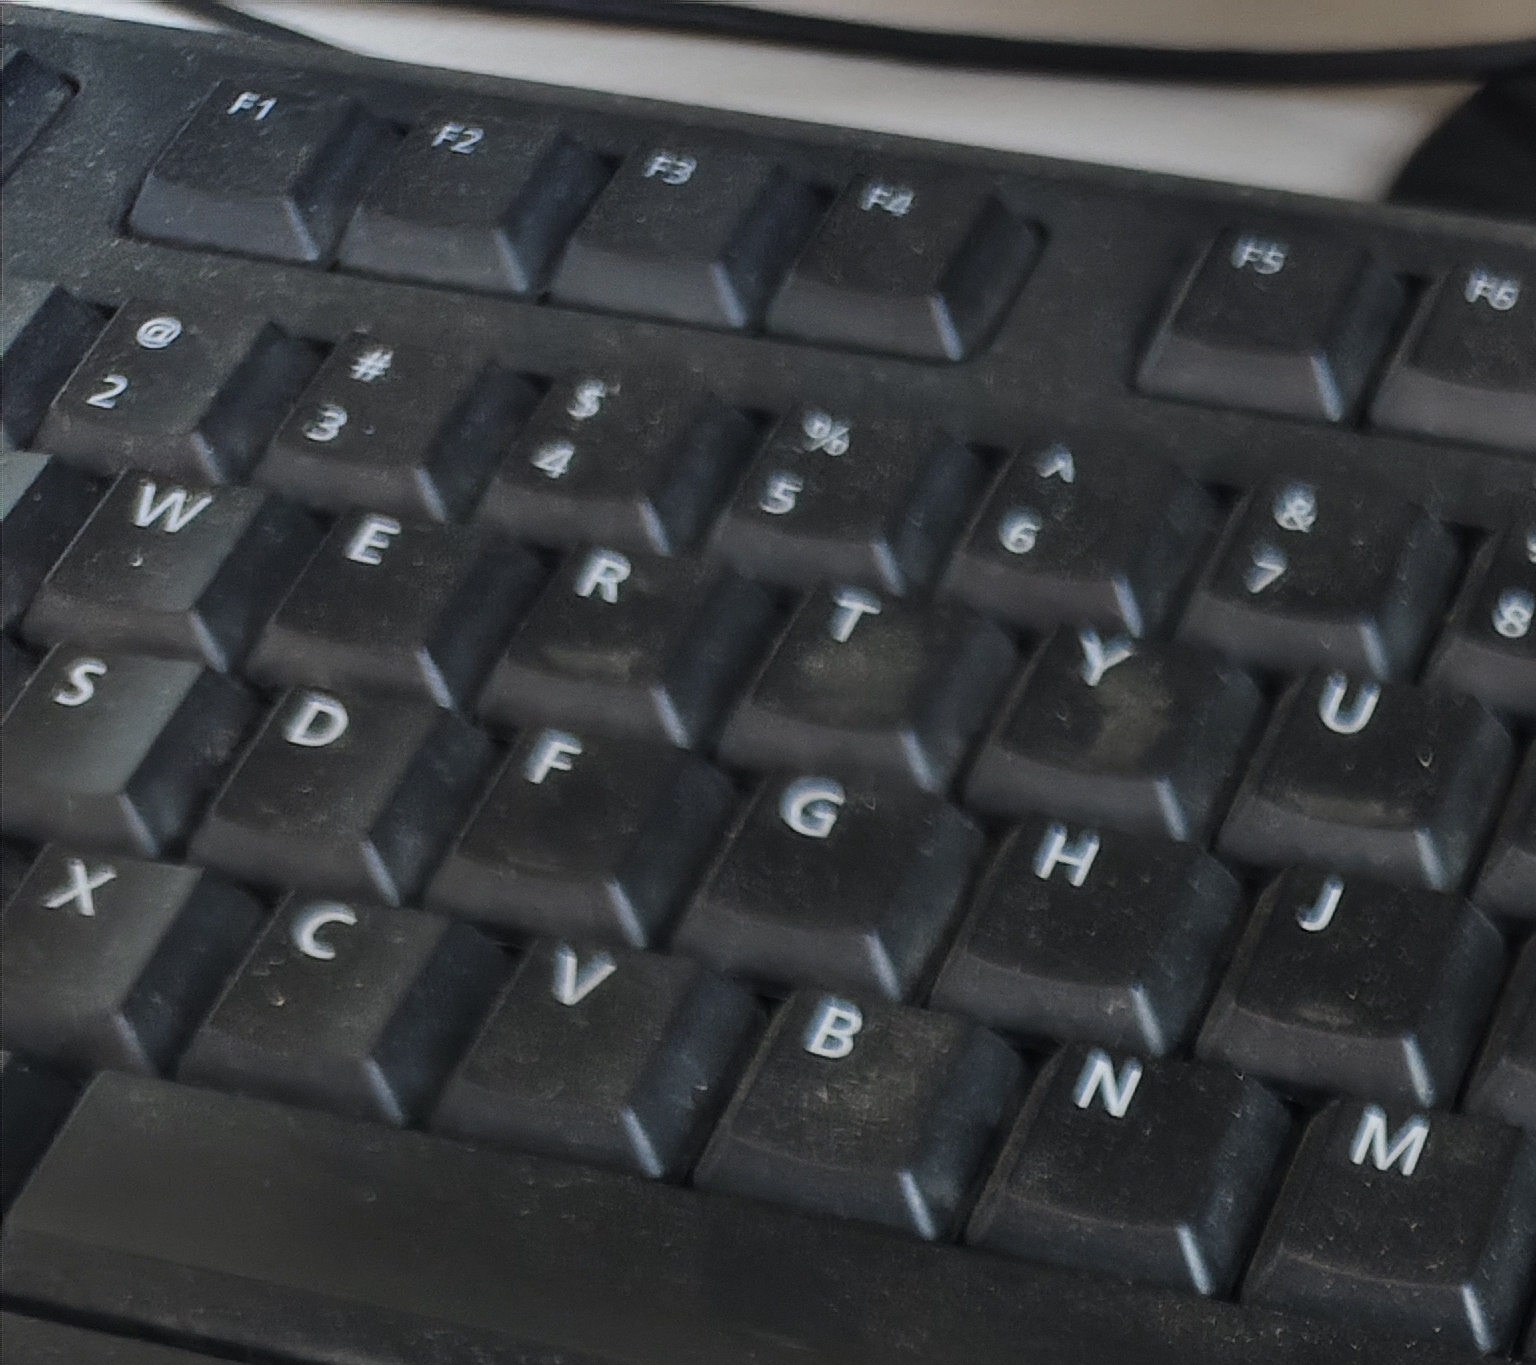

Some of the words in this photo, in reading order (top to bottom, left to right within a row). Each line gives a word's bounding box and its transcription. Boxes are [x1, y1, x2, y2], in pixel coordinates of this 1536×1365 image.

[227, 91, 277, 121] F1
[431, 121, 484, 154] F2
[644, 151, 697, 185] F3
[860, 185, 915, 217] F4
[1232, 240, 1286, 275] F5
[1465, 273, 1520, 311] F6
[136, 316, 182, 349] @
[351, 349, 393, 382] #
[86, 374, 128, 409] 2
[568, 383, 606, 421] $
[306, 404, 348, 442] 3
[804, 414, 850, 457] %
[533, 443, 575, 479] 4
[134, 482, 213, 533] W
[759, 475, 803, 515] 5
[1274, 489, 1316, 533] &
[346, 515, 401, 565] E
[1000, 515, 1041, 554] 6
[577, 549, 632, 604] R
[1248, 551, 1287, 594] 7
[833, 591, 881, 643] T
[1494, 596, 1534, 639] 8
[1081, 630, 1133, 687] Y
[54, 658, 107, 706] S
[1320, 673, 1382, 734] U
[286, 694, 349, 747] D
[527, 732, 583, 784] F
[781, 778, 846, 838] G
[1035, 828, 1100, 887] H
[45, 859, 117, 916] X
[1299, 883, 1343, 932] J
[294, 904, 358, 960] C
[554, 949, 617, 1006] V
[805, 996, 863, 1059] B
[1076, 1052, 1142, 1118] N
[1351, 1106, 1429, 1176] M
